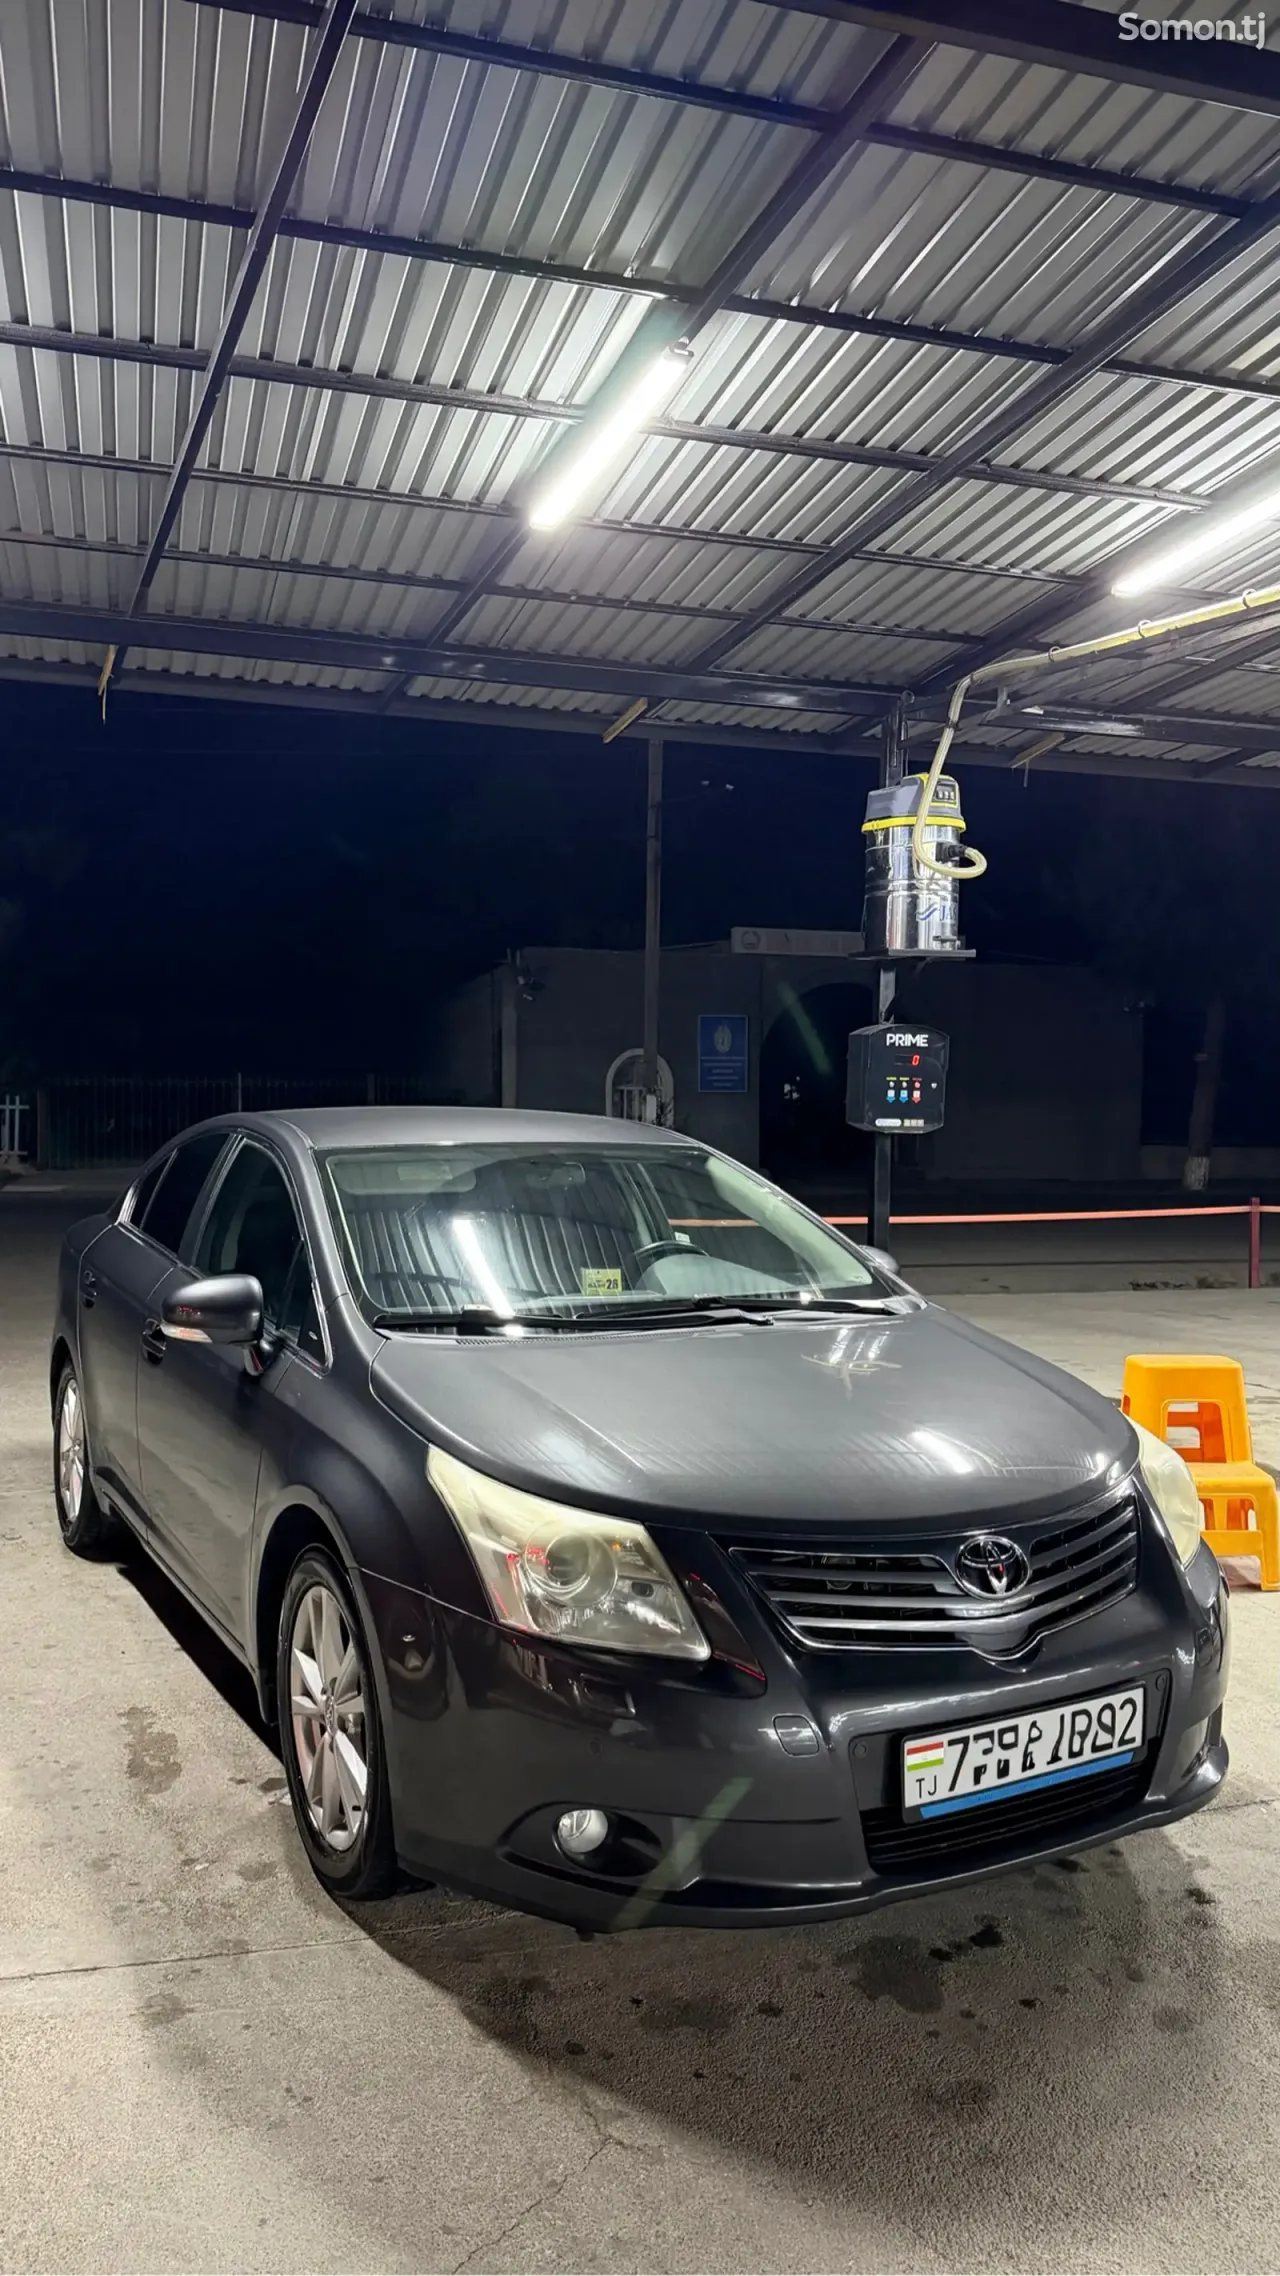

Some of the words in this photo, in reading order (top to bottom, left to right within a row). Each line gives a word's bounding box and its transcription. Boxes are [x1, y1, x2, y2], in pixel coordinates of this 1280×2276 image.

[886, 1033, 929, 1047] PRIME
[911, 1054, 921, 1066] 0
[915, 1775, 938, 1799] TJ
